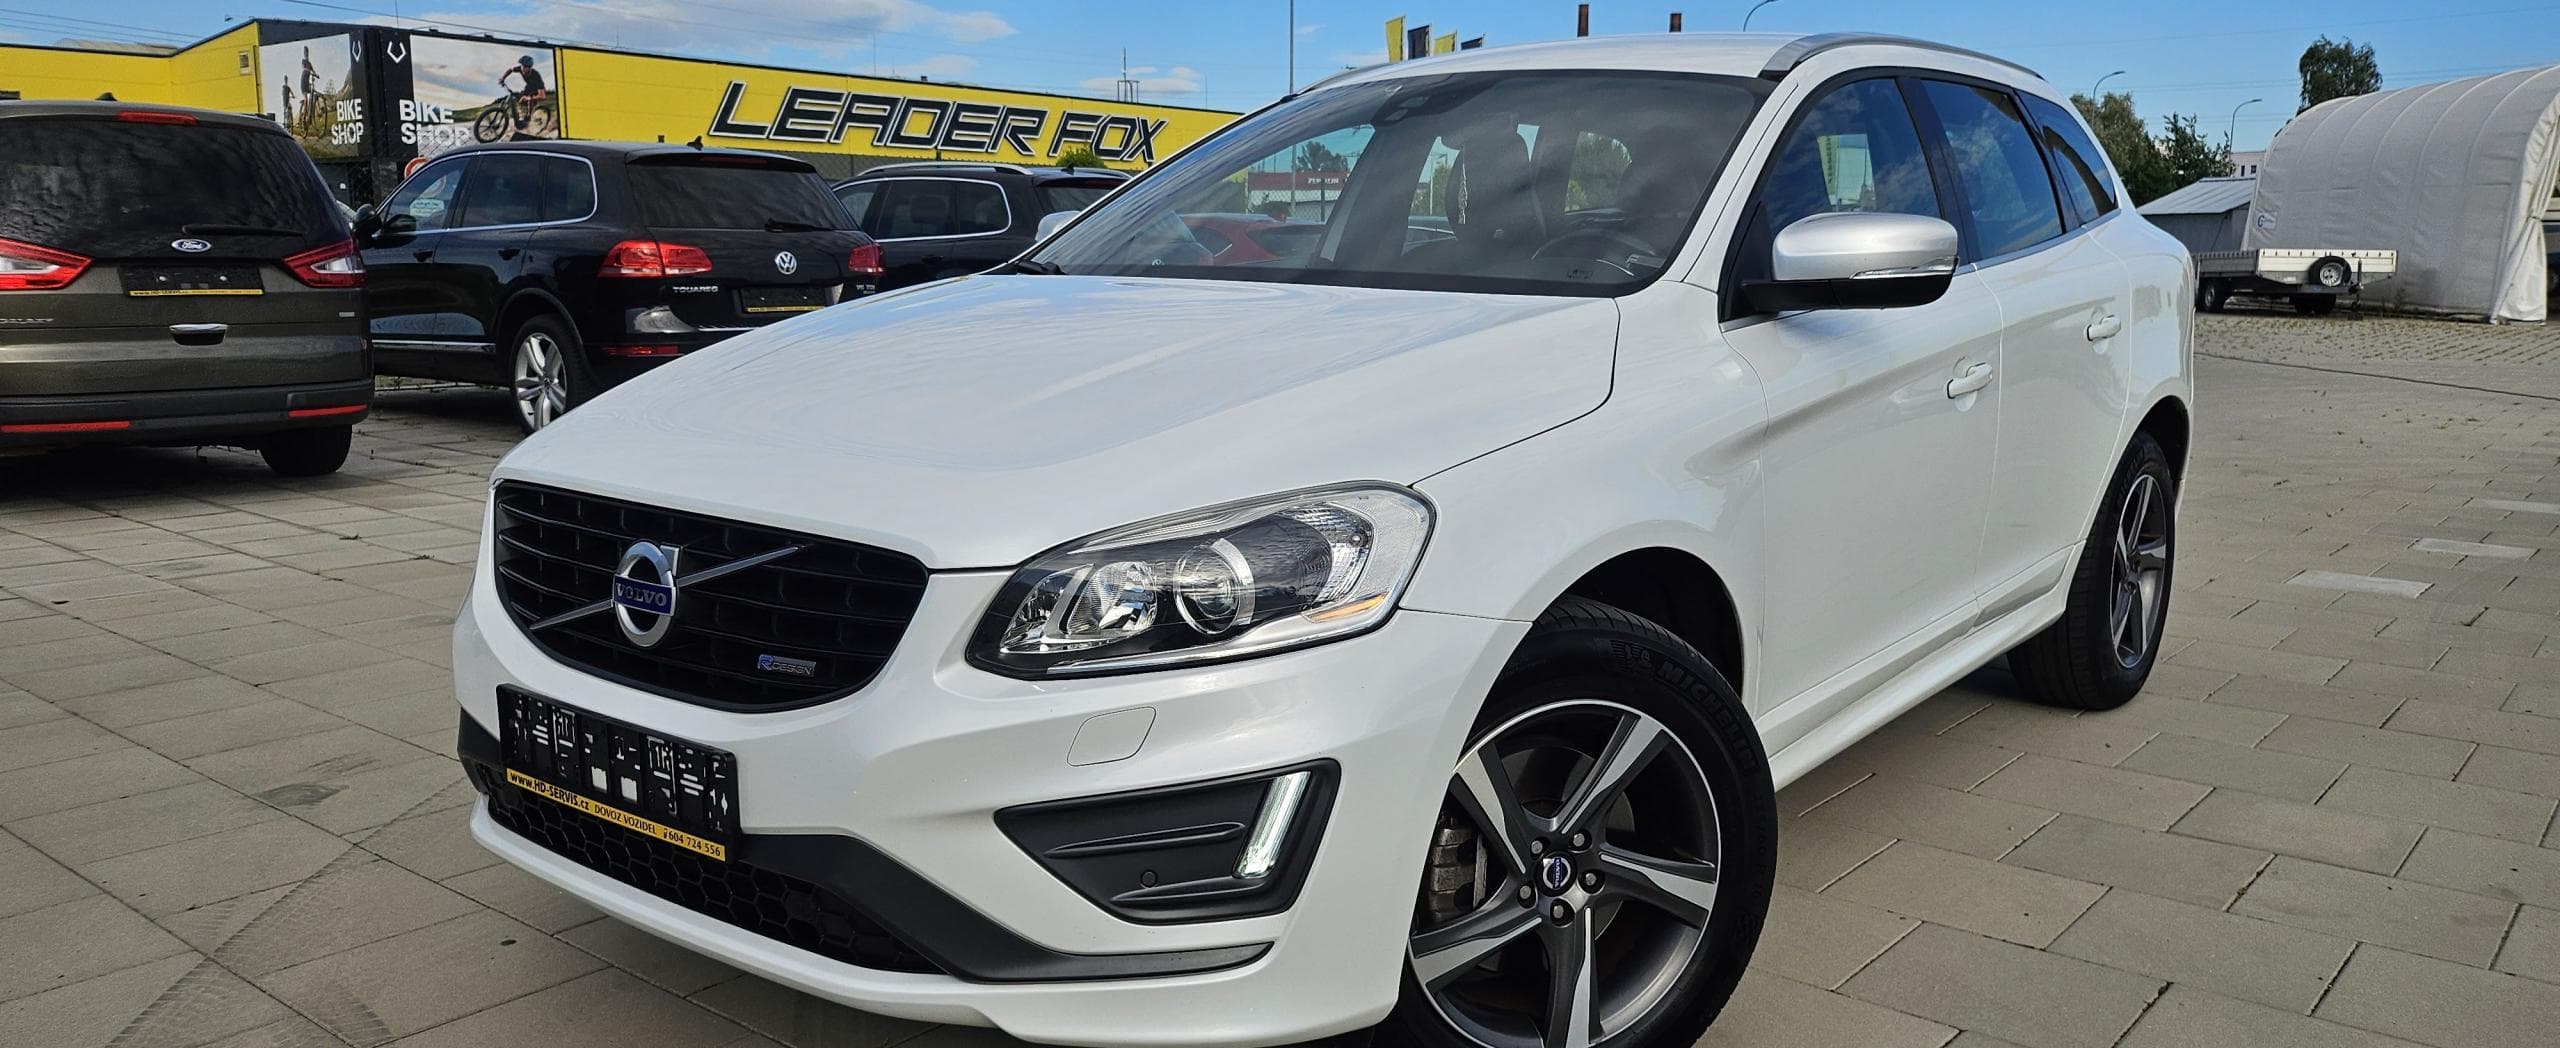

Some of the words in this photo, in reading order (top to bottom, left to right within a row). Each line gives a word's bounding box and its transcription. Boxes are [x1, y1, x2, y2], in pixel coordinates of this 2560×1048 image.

[336, 98, 363, 122] BIKE
[399, 99, 454, 124] BIKE
[708, 80, 1048, 156] LEADER
[1047, 110, 1169, 163] FOX
[331, 122, 364, 145] SHOP
[401, 122, 470, 147] SHOP
[672, 285, 719, 293] TOUAREG
[616, 582, 667, 607] VOLVO
[1657, 660, 1760, 777] MICHELIN
[594, 804, 621, 823] DOVOZ
[623, 815, 656, 835] VOZIDEL
[668, 830, 684, 844] 604
[705, 845, 721, 857] 556
